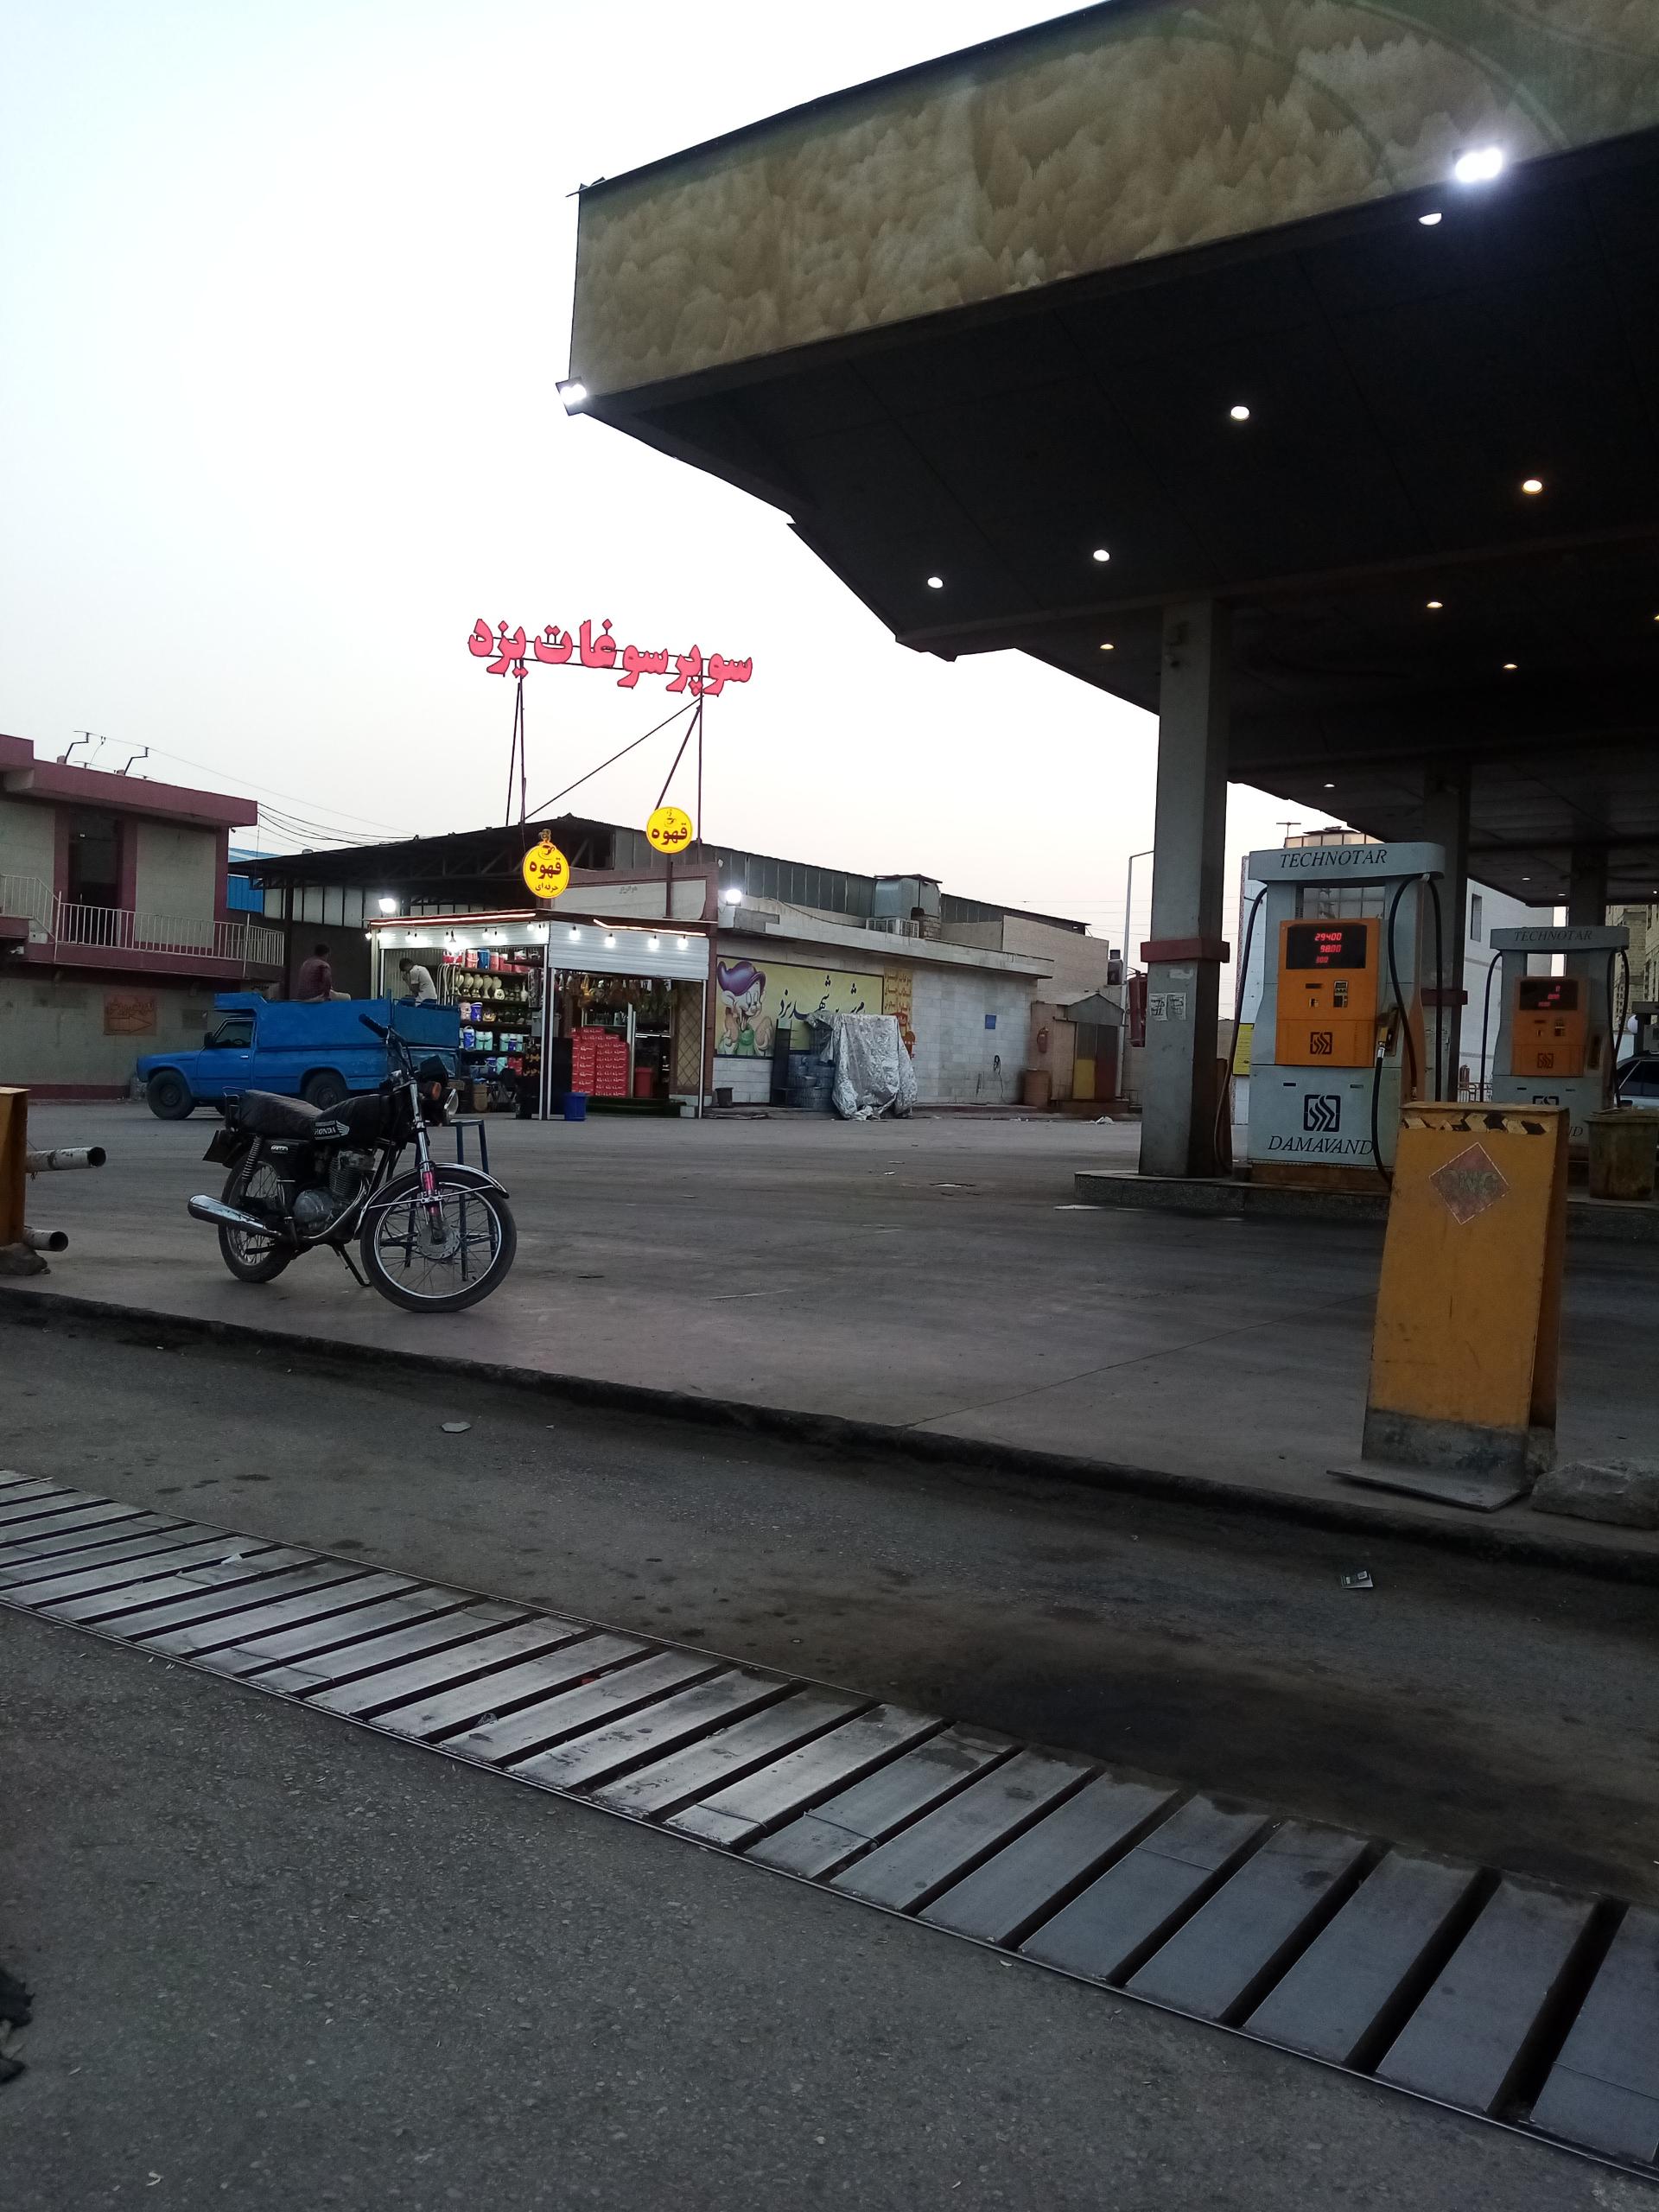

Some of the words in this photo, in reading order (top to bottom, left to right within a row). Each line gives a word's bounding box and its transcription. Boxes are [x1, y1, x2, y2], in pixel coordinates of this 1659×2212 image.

[467, 618, 527, 678] یزد
[533, 619, 669, 689] سوغات
[666, 645, 753, 696] سوپر
[652, 823, 688, 846] قهوه
[529, 857, 562, 880] قهوه
[1280, 849, 1388, 868] TECHNOTAR
[1514, 930, 1592, 942] TECHNOTAR
[1267, 1135, 1374, 1155] DAMAVAND
